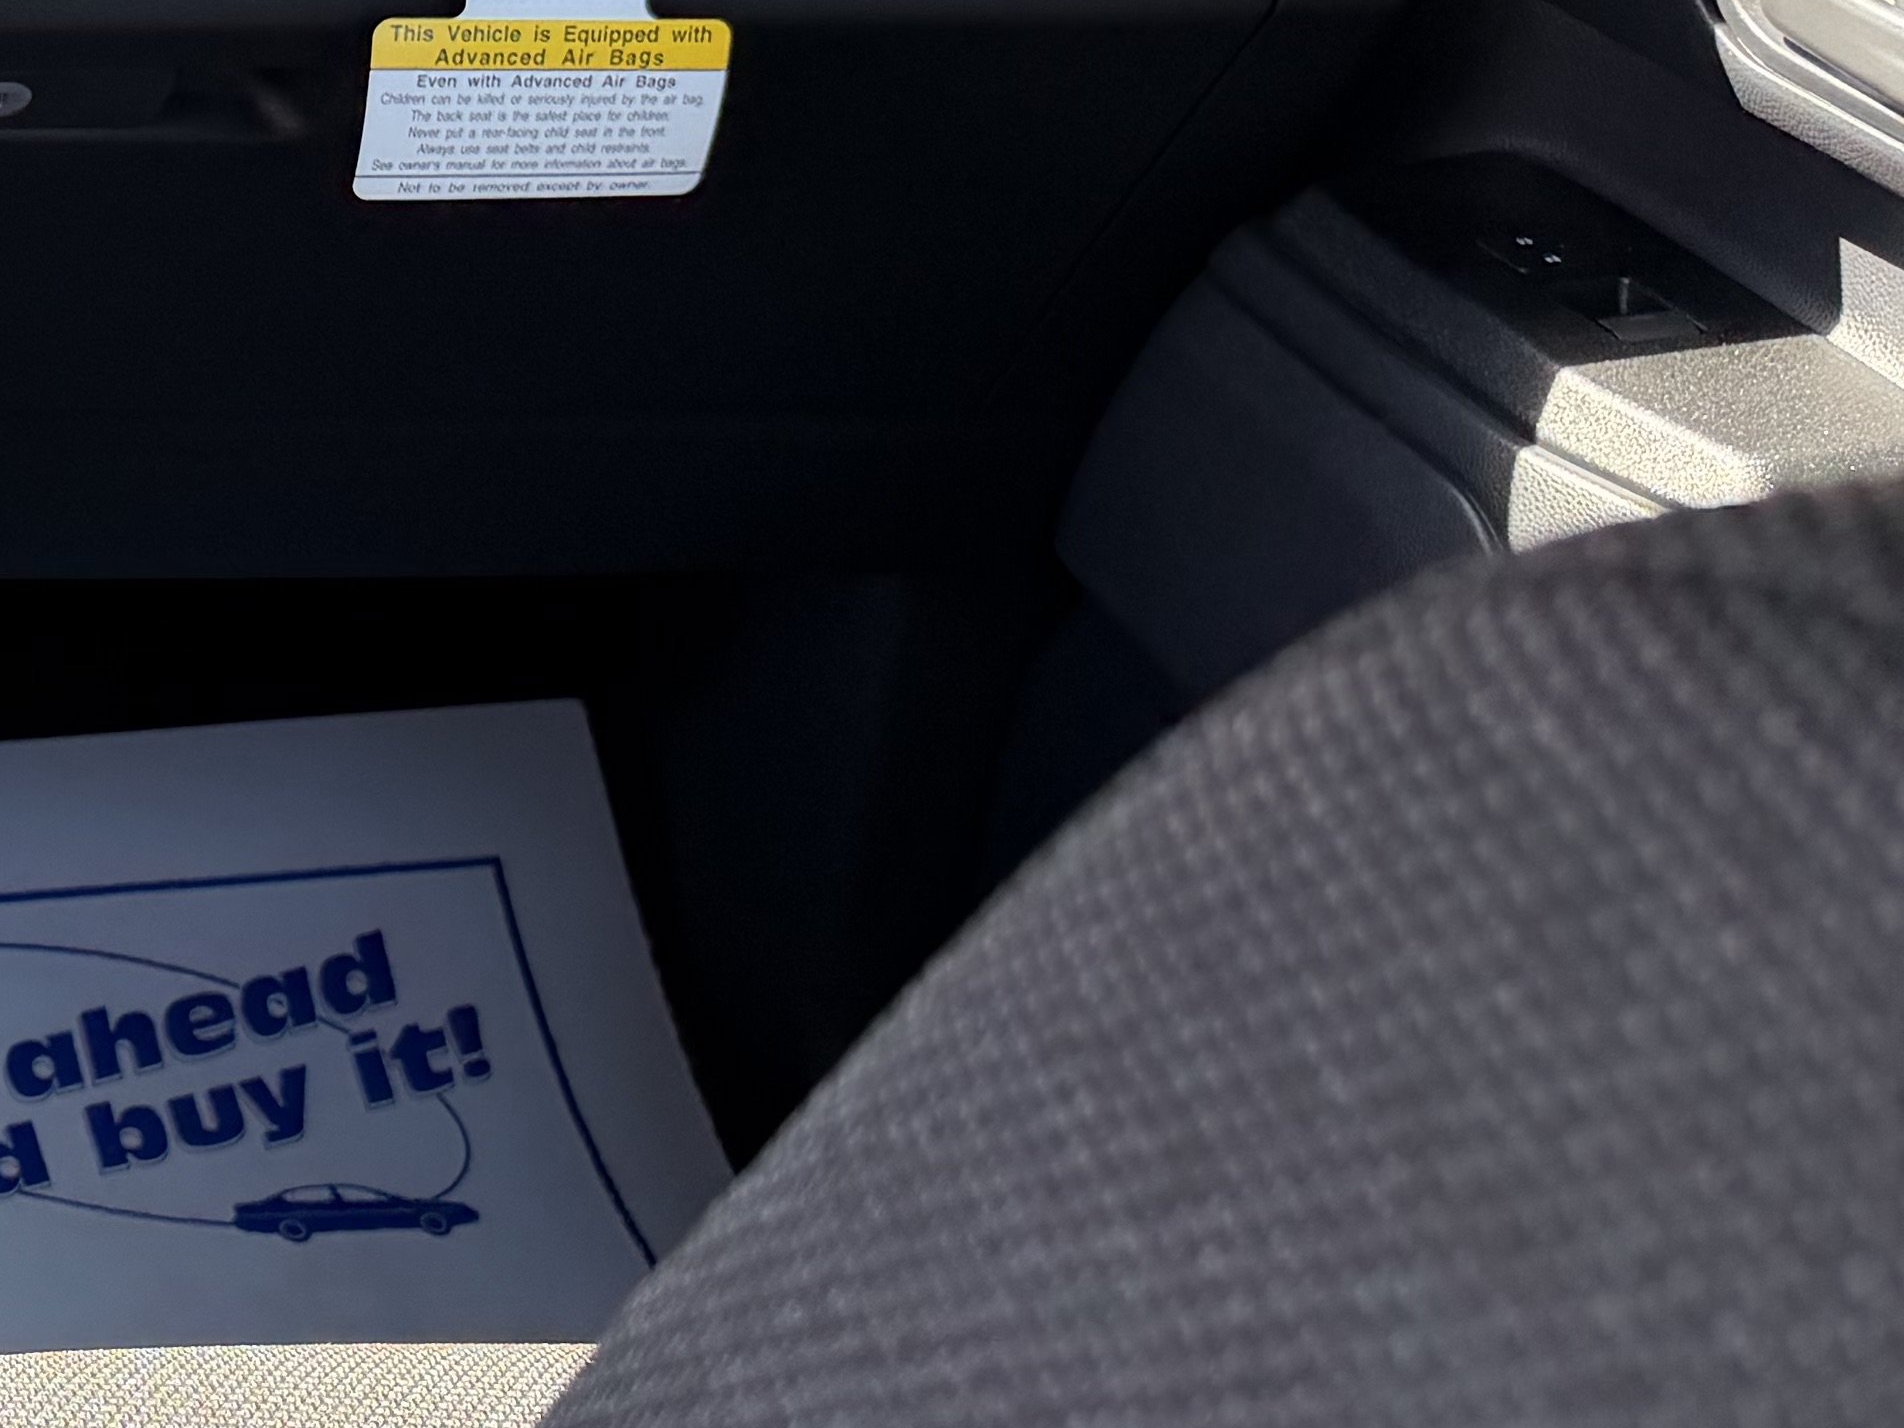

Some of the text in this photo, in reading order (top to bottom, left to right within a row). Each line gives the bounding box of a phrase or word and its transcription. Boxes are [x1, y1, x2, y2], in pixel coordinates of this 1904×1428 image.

[391, 25, 713, 47] This Vehicle is Equipped with
[435, 48, 665, 69] Advanced Air Bags
[417, 74, 676, 91] Even with Advanced Air Bags
[380, 92, 425, 105] Children
[431, 94, 451, 105] can
[457, 93, 471, 105] be
[477, 92, 505, 105] killed
[528, 93, 575, 107] seriously
[581, 93, 616, 107] injured
[621, 93, 636, 107] by
[642, 93, 658, 105] the
[664, 94, 678, 105] air
[411, 109, 431, 121] The
[437, 109, 462, 121] back
[468, 110, 493, 121] seat
[498, 110, 507, 121] is
[513, 110, 529, 121] the
[535, 109, 567, 121] safest
[573, 110, 601, 123] place
[607, 110, 622, 121] for
[408, 126, 440, 138] Never
[445, 128, 463, 140] put
[482, 127, 539, 140] rear-facing
[544, 126, 569, 138] child
[575, 127, 598, 138] seat
[618, 127, 636, 137] the
[417, 143, 596, 156] Always use seat belts and child
[446, 159, 486, 170] manual
[510, 160, 539, 170] more
[606, 158, 636, 169] about
[397, 182, 421, 193] Not
[428, 182, 441, 193] to
[448, 182, 465, 193] be
[473, 181, 531, 193] removed
[5, 928, 398, 1100] ahead
[86, 1061, 308, 1175] buy
[350, 1003, 492, 1109] it!
